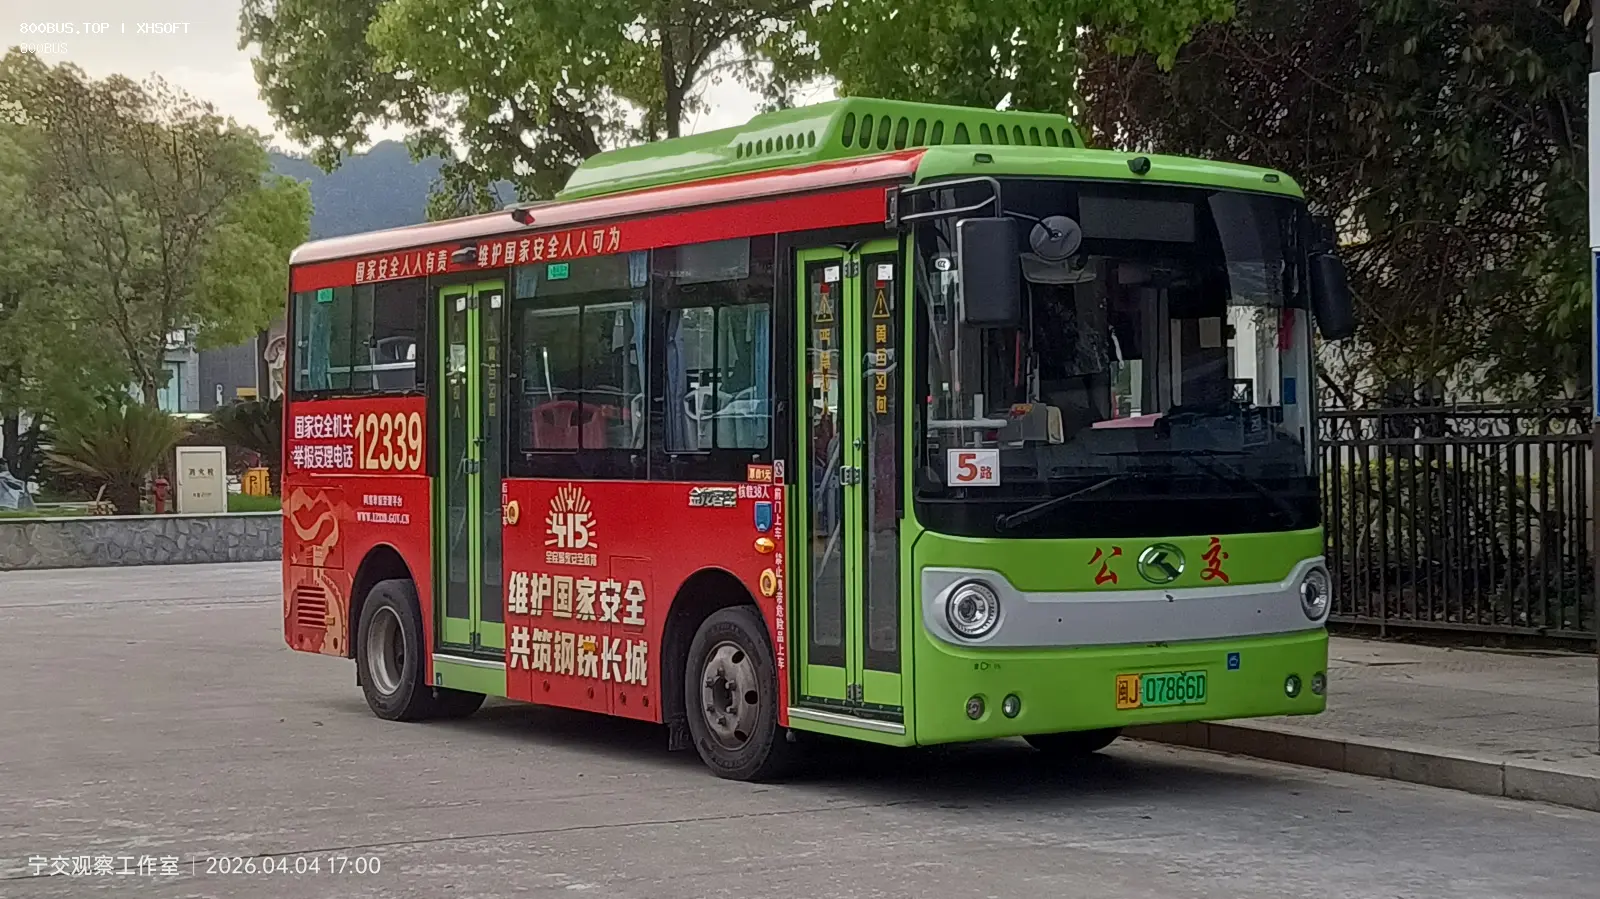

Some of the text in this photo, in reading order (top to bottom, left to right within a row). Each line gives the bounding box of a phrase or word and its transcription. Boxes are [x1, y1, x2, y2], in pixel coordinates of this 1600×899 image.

[356, 227, 621, 284] 国家安全人人有责 维护国家安全人人可为
[294, 412, 354, 439] 国家安全机关
[355, 411, 423, 471] 12339
[293, 444, 354, 469] 举报受理电话
[956, 453, 993, 482] 5路
[774, 487, 783, 539] 前门上车
[1088, 537, 1230, 586] 公 交
[508, 571, 647, 627] 维护国家安全
[510, 626, 648, 687] 共筑钢铁长城
[1146, 675, 1206, 702] 07866D
